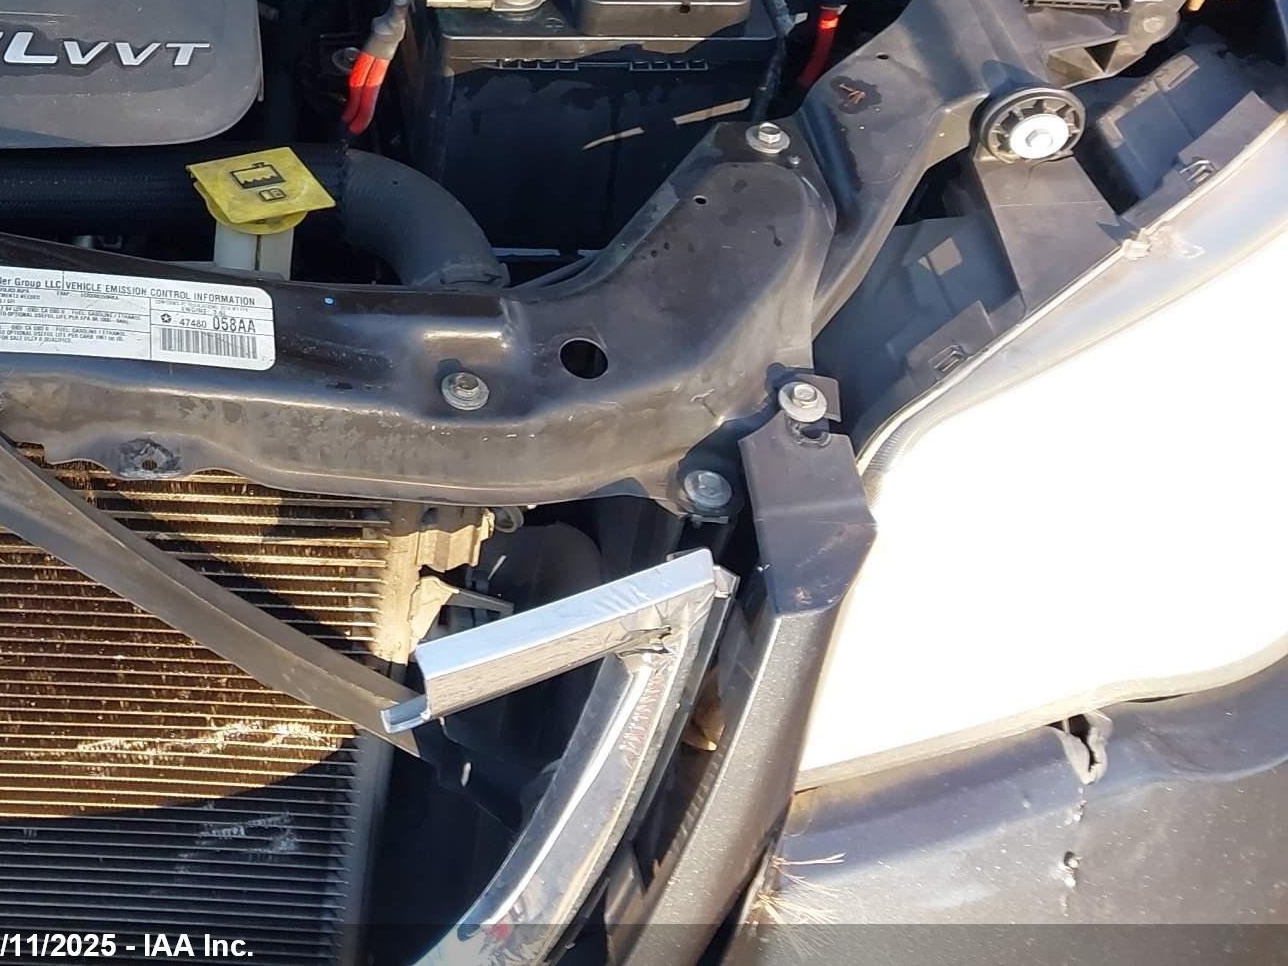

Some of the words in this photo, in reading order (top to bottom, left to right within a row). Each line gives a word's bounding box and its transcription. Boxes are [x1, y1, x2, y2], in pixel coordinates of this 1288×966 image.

[63, 41, 210, 66] VVT
[14, 277, 42, 288] Group
[45, 280, 62, 289] LLC
[65, 281, 102, 292] VEHICLE
[105, 284, 147, 296] EMISSION
[150, 288, 191, 300] CONTROL
[193, 292, 255, 306] INFORMATION
[179, 318, 207, 329] 47480
[212, 315, 256, 334] 058AA
